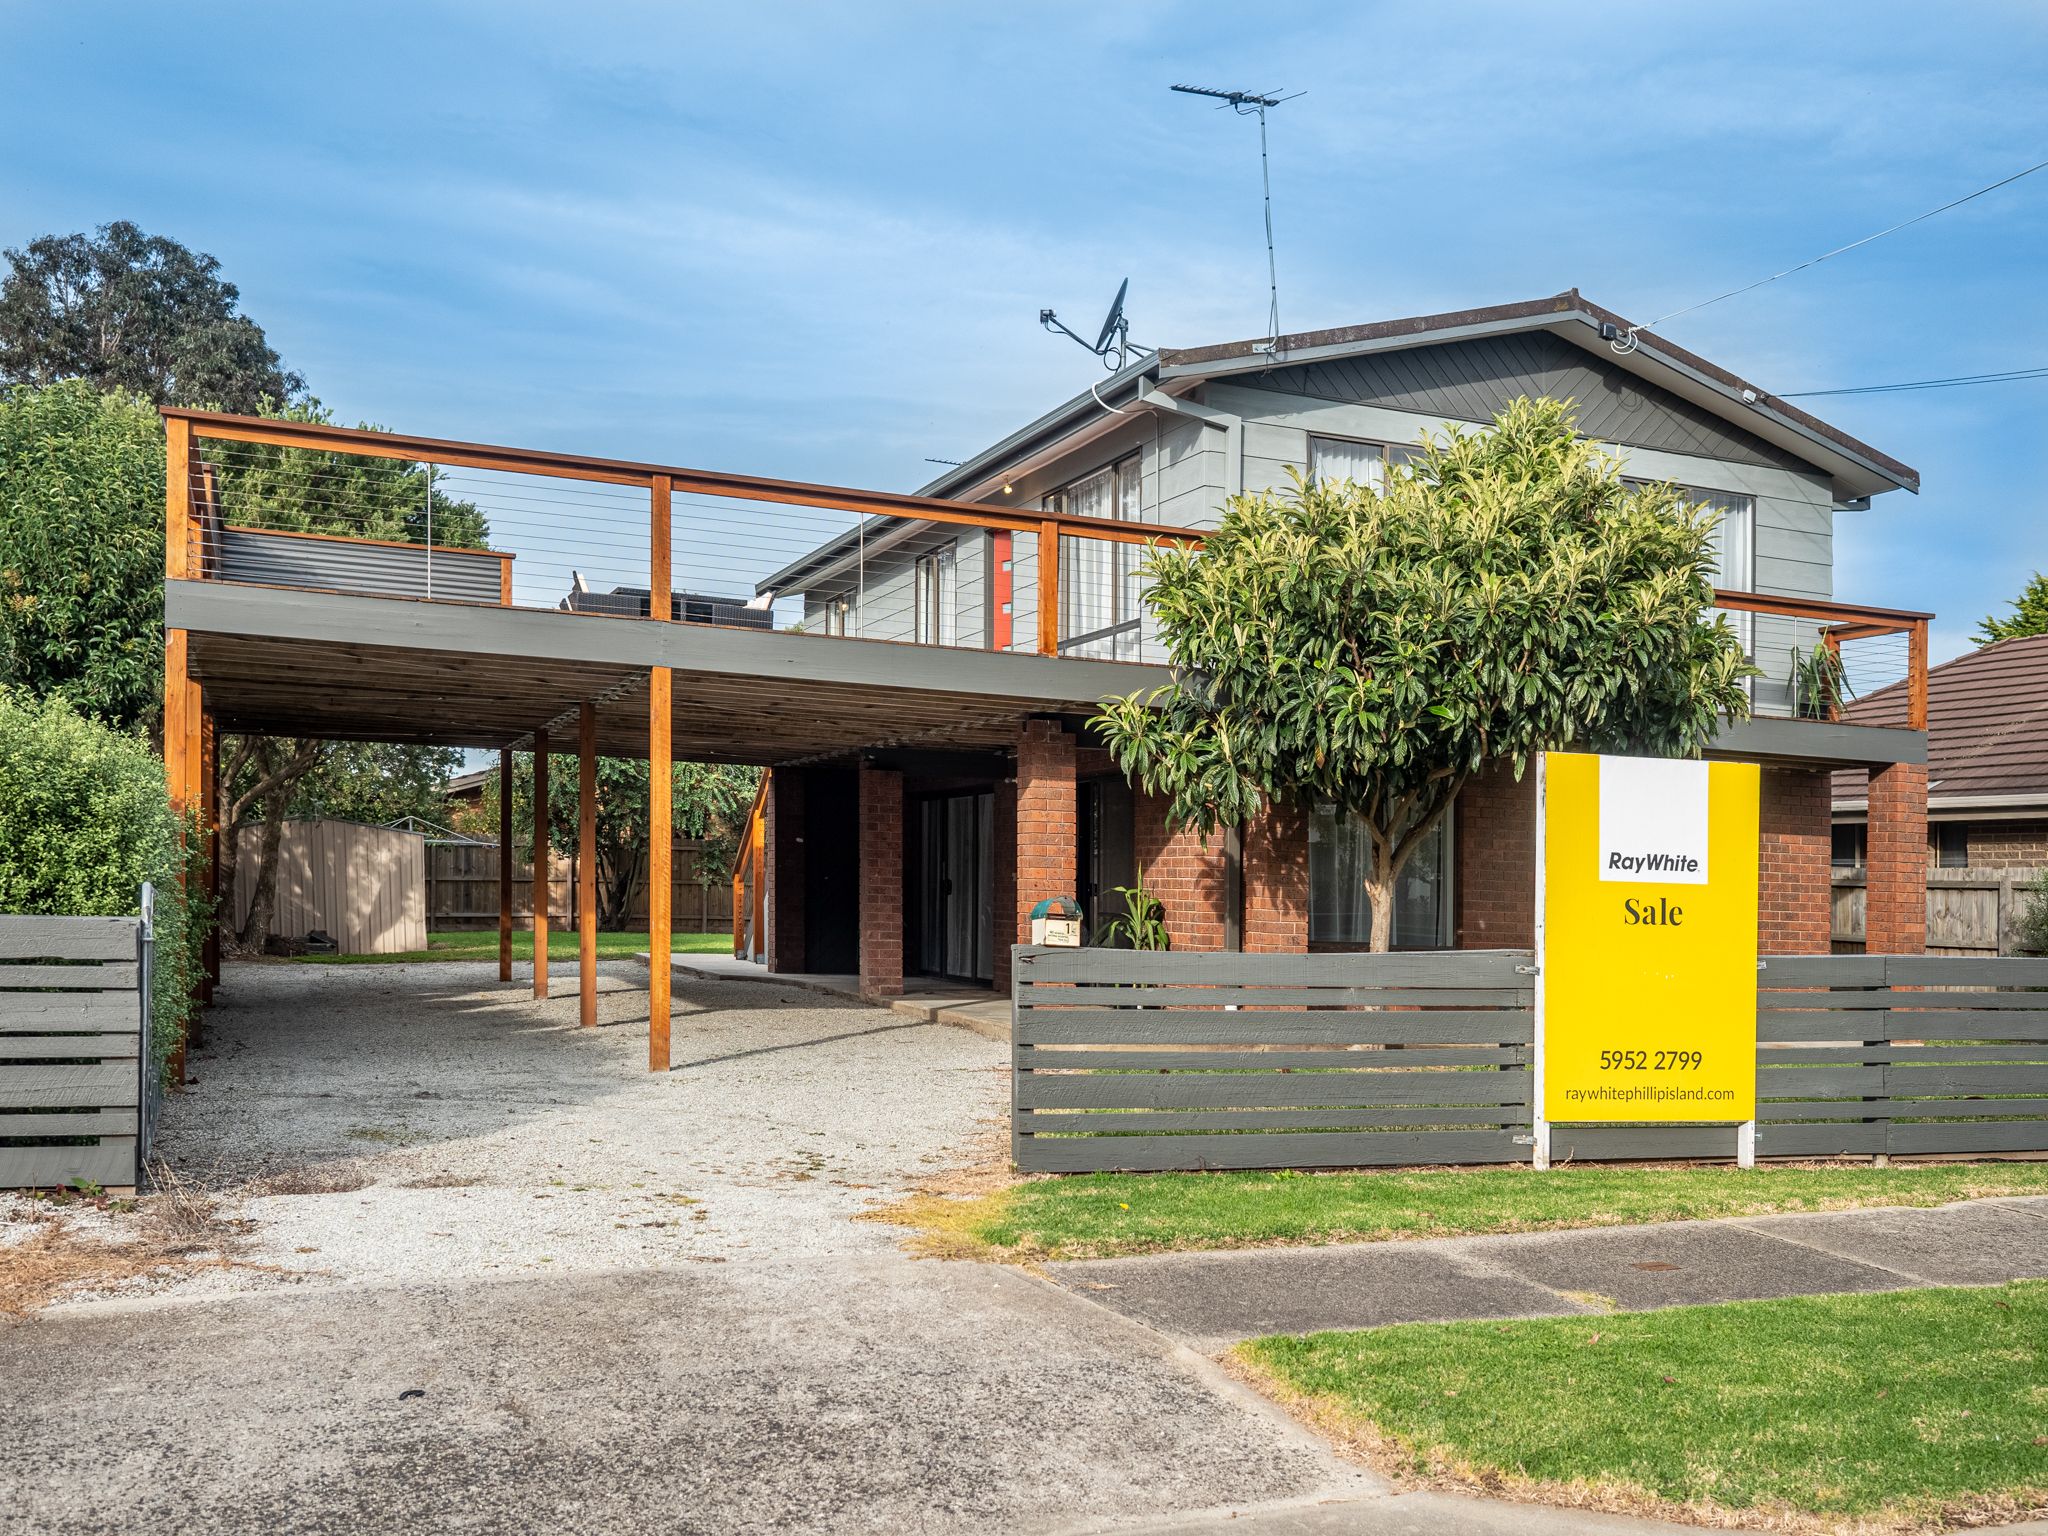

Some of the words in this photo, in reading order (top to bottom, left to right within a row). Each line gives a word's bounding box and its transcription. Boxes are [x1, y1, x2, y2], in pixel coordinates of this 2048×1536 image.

[1624, 897, 1683, 927] Sale
[1600, 1050, 1647, 1070] 5952
[1654, 1051, 1703, 1070] 2799
[1565, 1086, 1735, 1103] raywhitephillipisland.com
